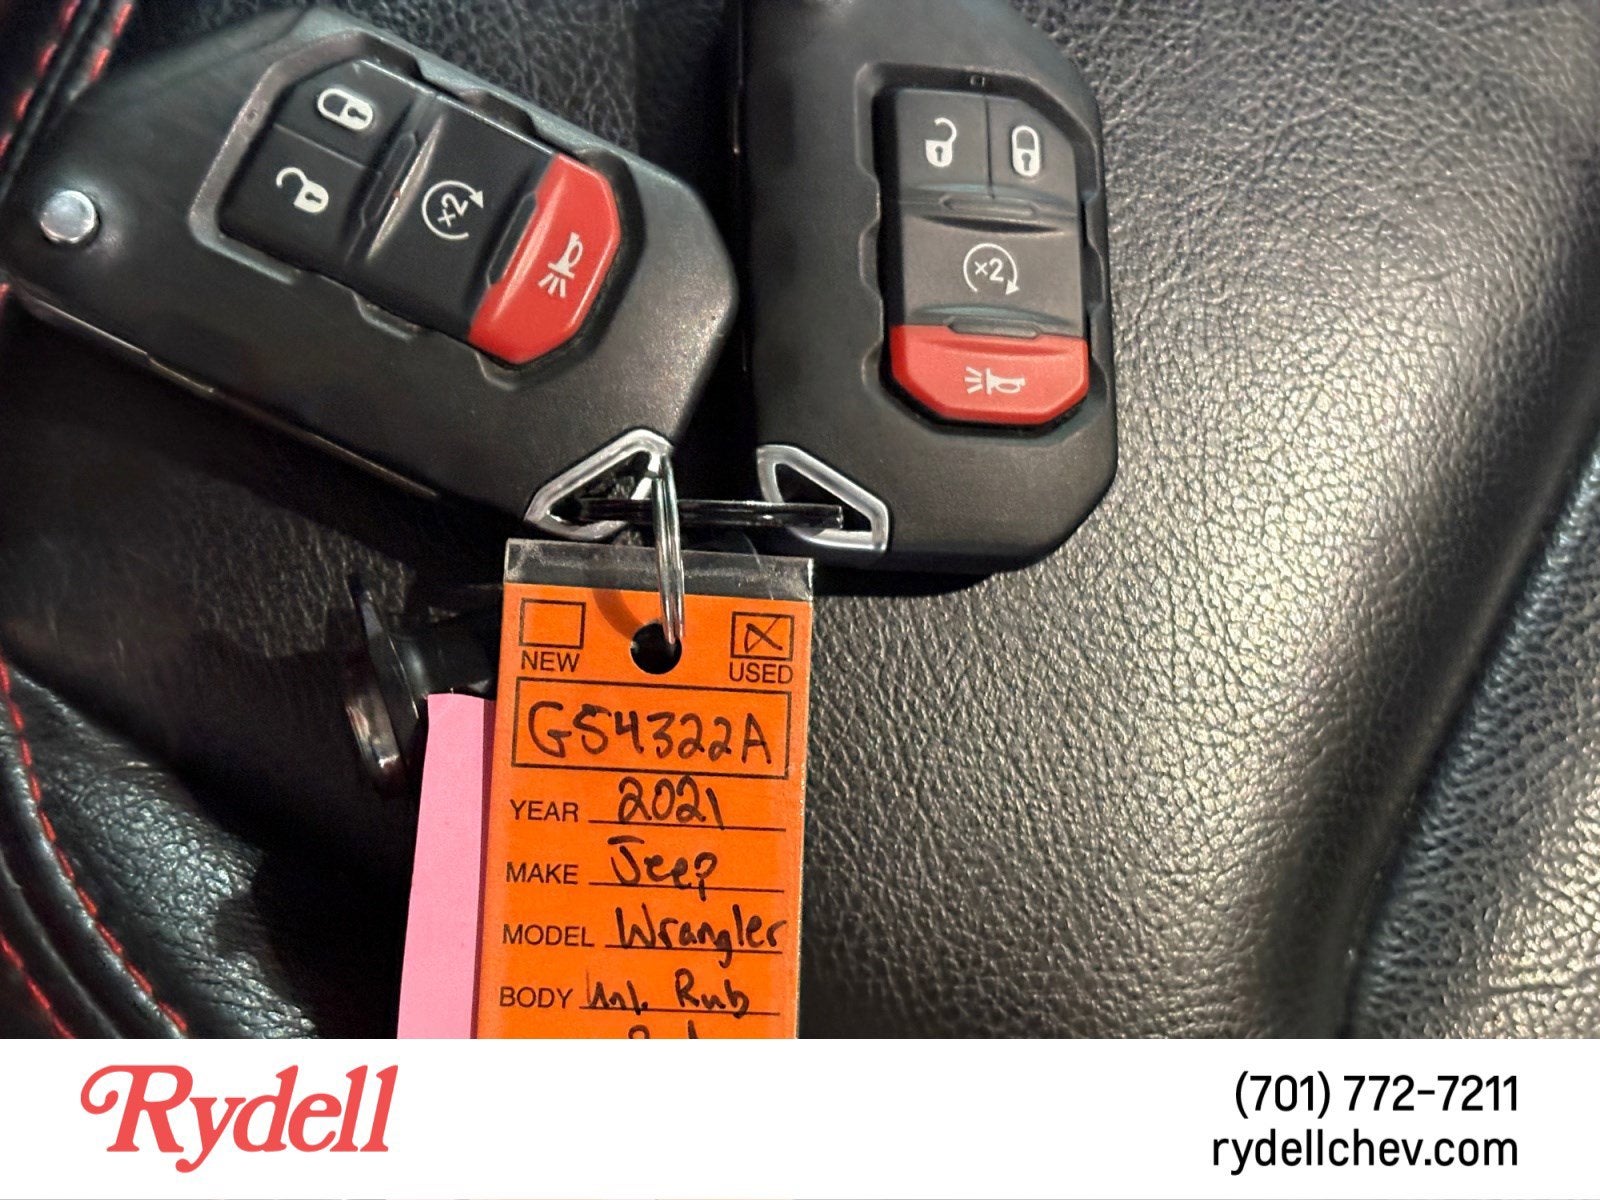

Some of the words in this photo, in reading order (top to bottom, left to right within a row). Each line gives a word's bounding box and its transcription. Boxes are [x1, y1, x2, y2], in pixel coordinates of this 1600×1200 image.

[520, 650, 580, 673] NEW
[728, 661, 793, 684] USED
[509, 798, 579, 823] YEAR
[617, 775, 726, 831] 2021
[505, 862, 579, 885] MAKE
[607, 834, 718, 902] Jeep
[502, 923, 595, 948] MODEL
[615, 902, 787, 969] Wrangler
[499, 986, 573, 1009] BODY
[674, 967, 750, 1019] Rub
